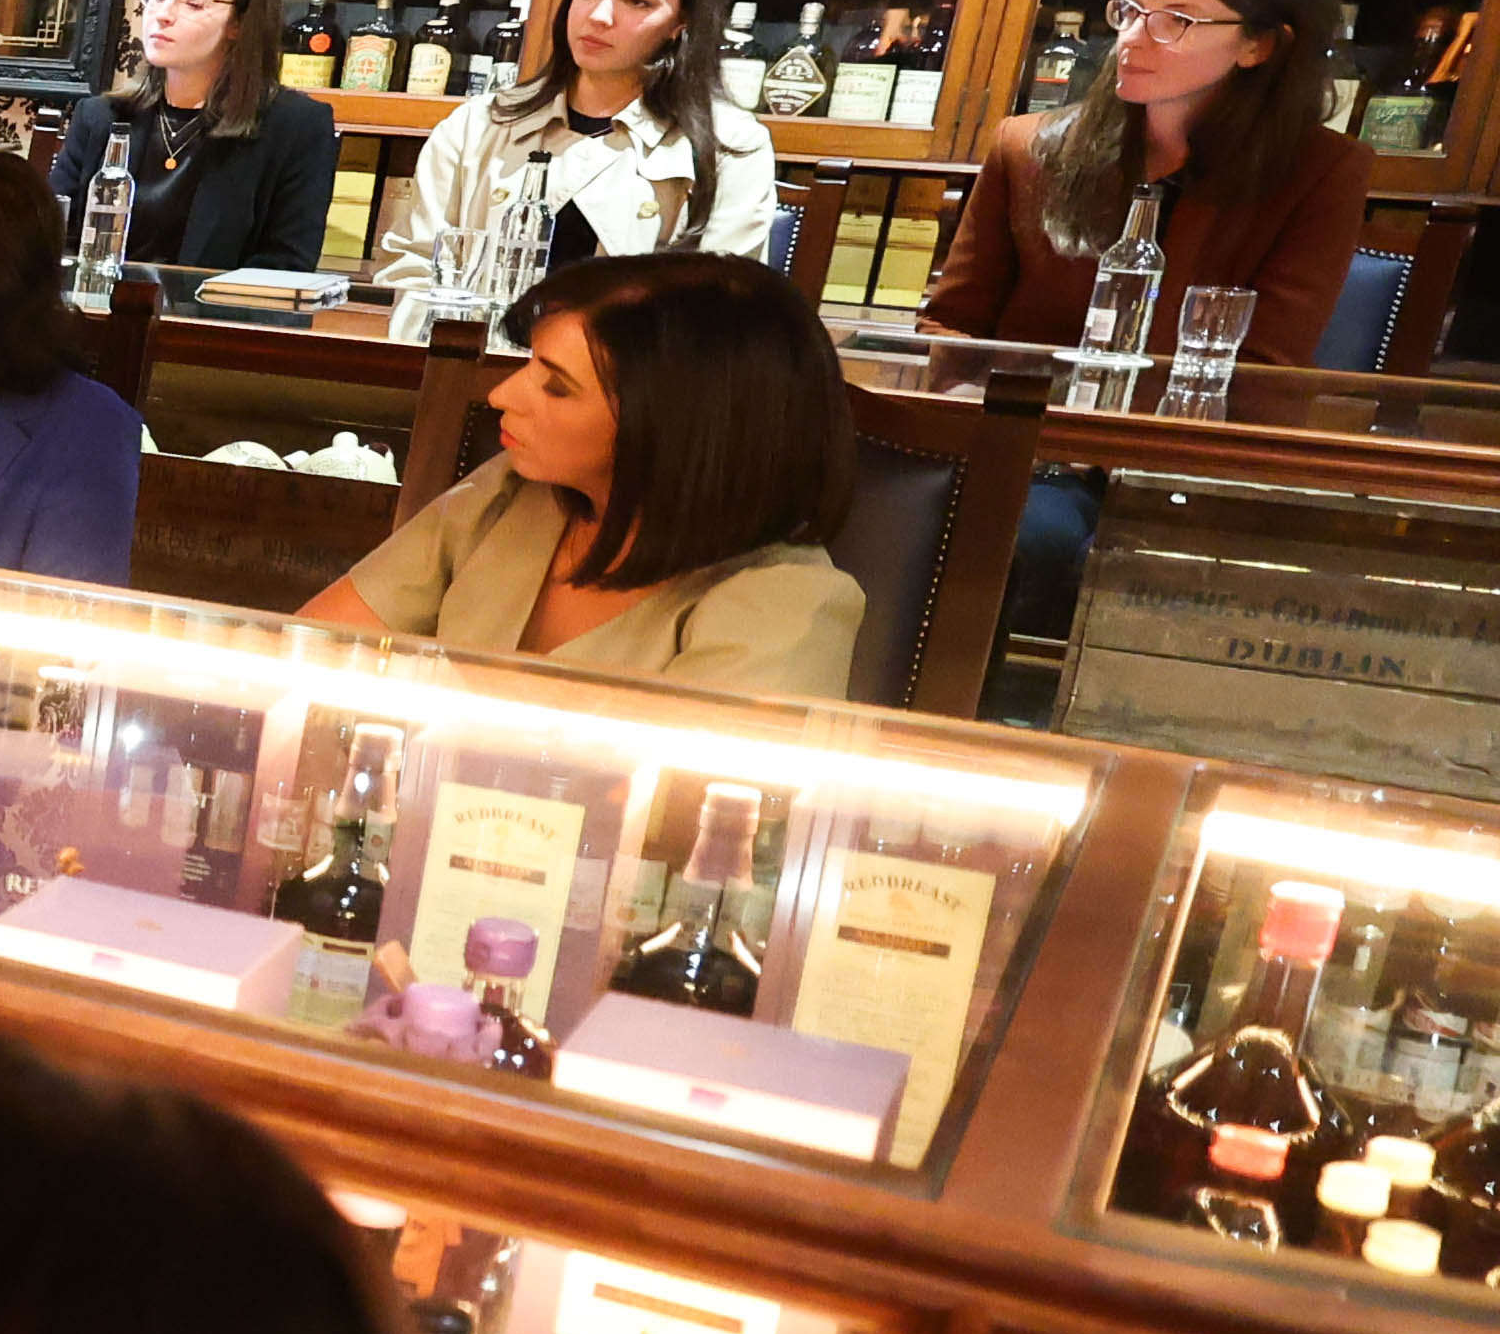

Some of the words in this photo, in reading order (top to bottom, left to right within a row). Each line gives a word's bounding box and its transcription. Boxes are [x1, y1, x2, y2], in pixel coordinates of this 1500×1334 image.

[1228, 637, 1408, 677] DUBLIN
[454, 807, 556, 840] REDBREAST
[843, 875, 962, 911] REDBREAST
